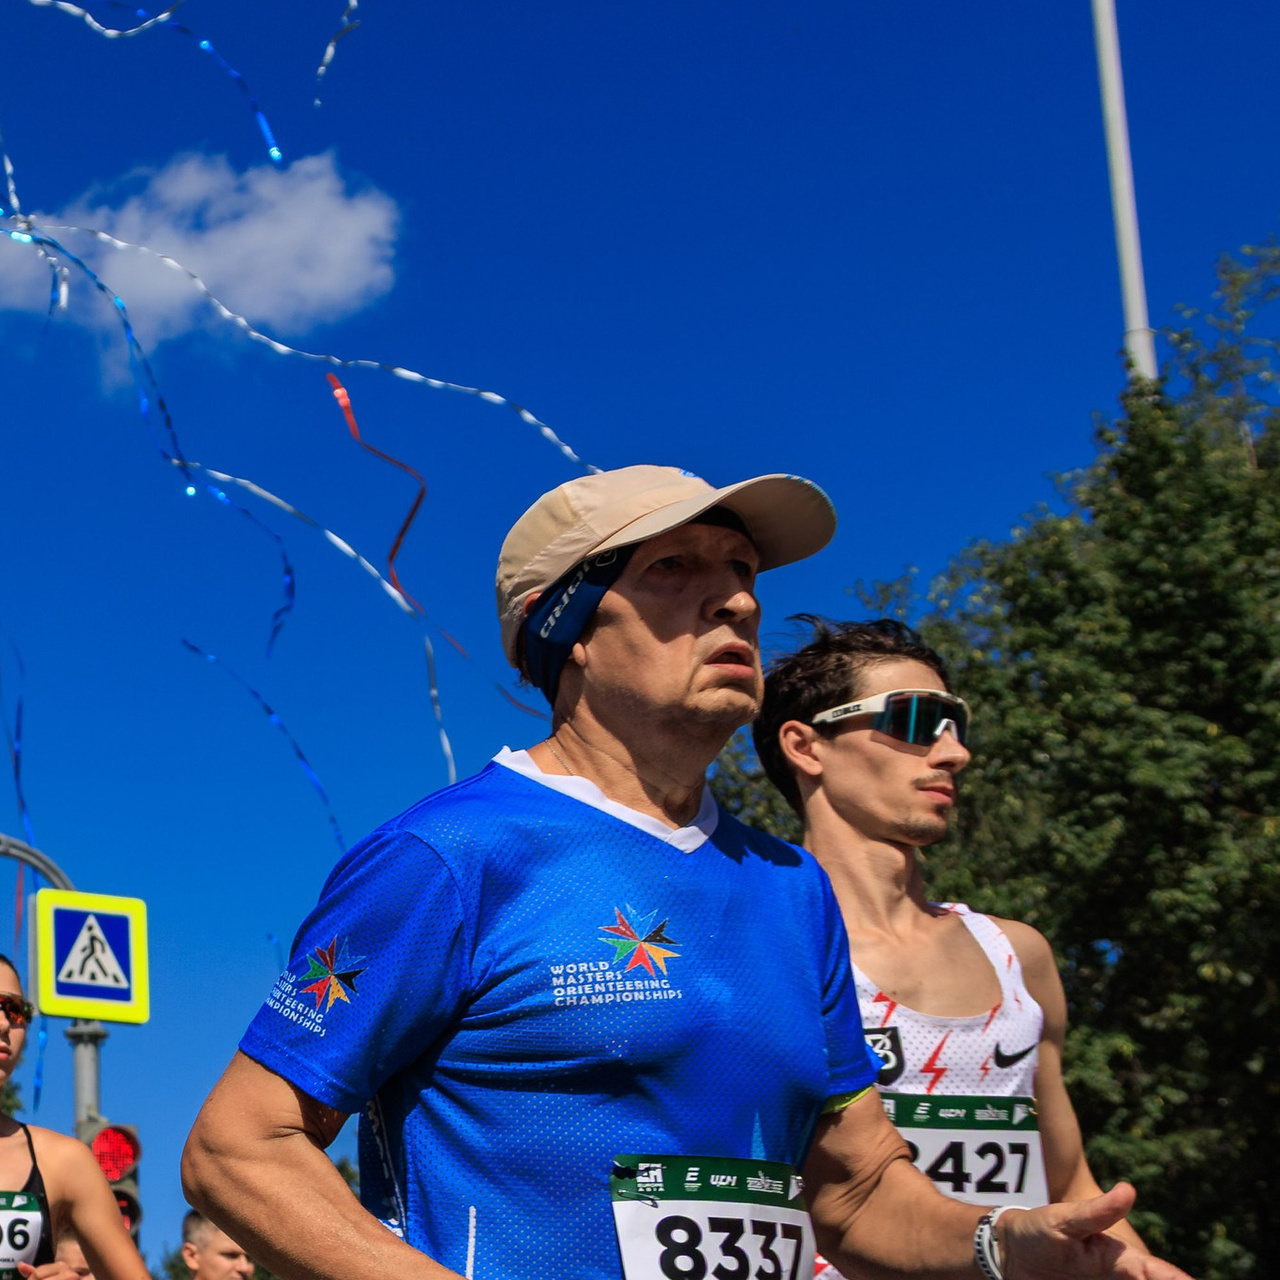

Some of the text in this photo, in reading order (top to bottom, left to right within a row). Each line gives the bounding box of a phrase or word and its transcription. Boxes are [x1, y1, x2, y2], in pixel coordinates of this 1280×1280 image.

[550, 961, 610, 975] WORLD
[552, 971, 622, 986] MASTERS
[553, 979, 671, 996] ORIENTEERING
[554, 989, 683, 1007] CHAMPIONSHIPS
[906, 1140, 1029, 1194] 427
